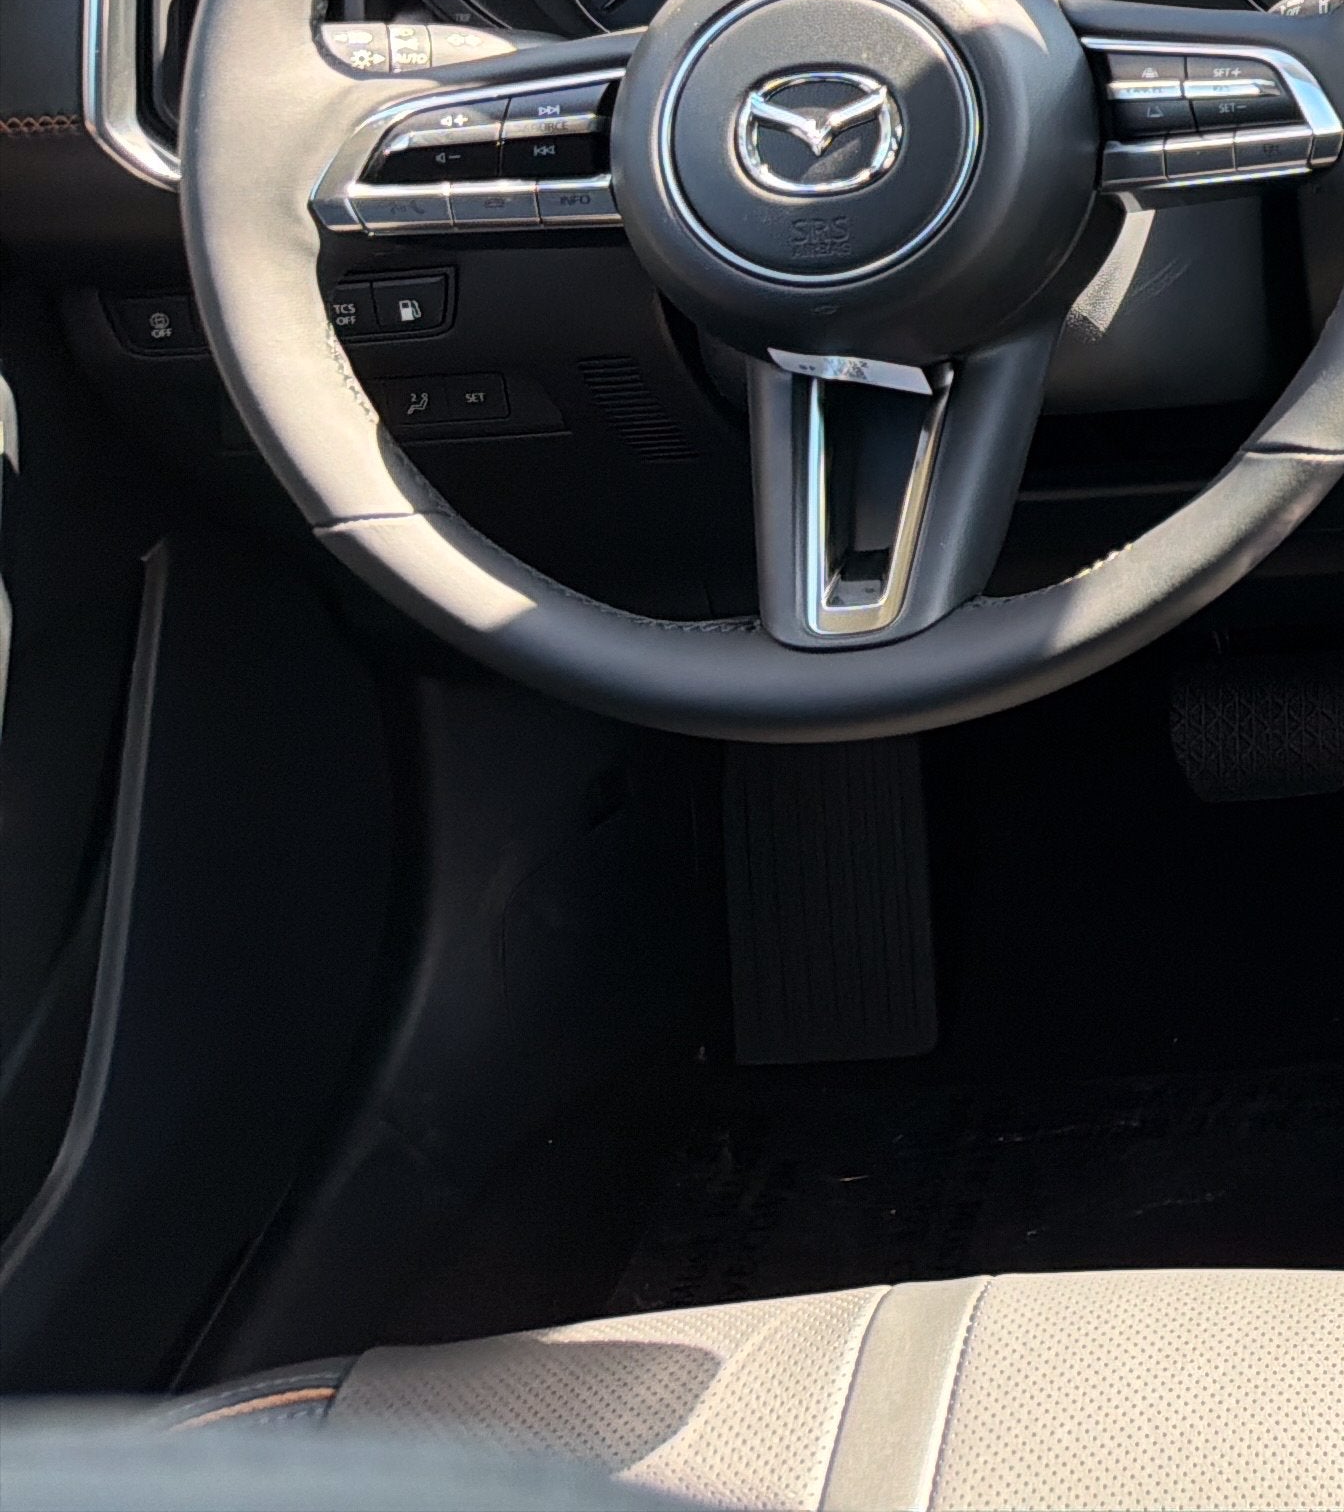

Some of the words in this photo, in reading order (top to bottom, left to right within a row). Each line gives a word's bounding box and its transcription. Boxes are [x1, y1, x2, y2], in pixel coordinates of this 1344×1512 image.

[561, 194, 591, 205] INFO
[333, 304, 356, 314] TCS
[336, 316, 356, 325] OFF
[465, 393, 485, 402] SET
